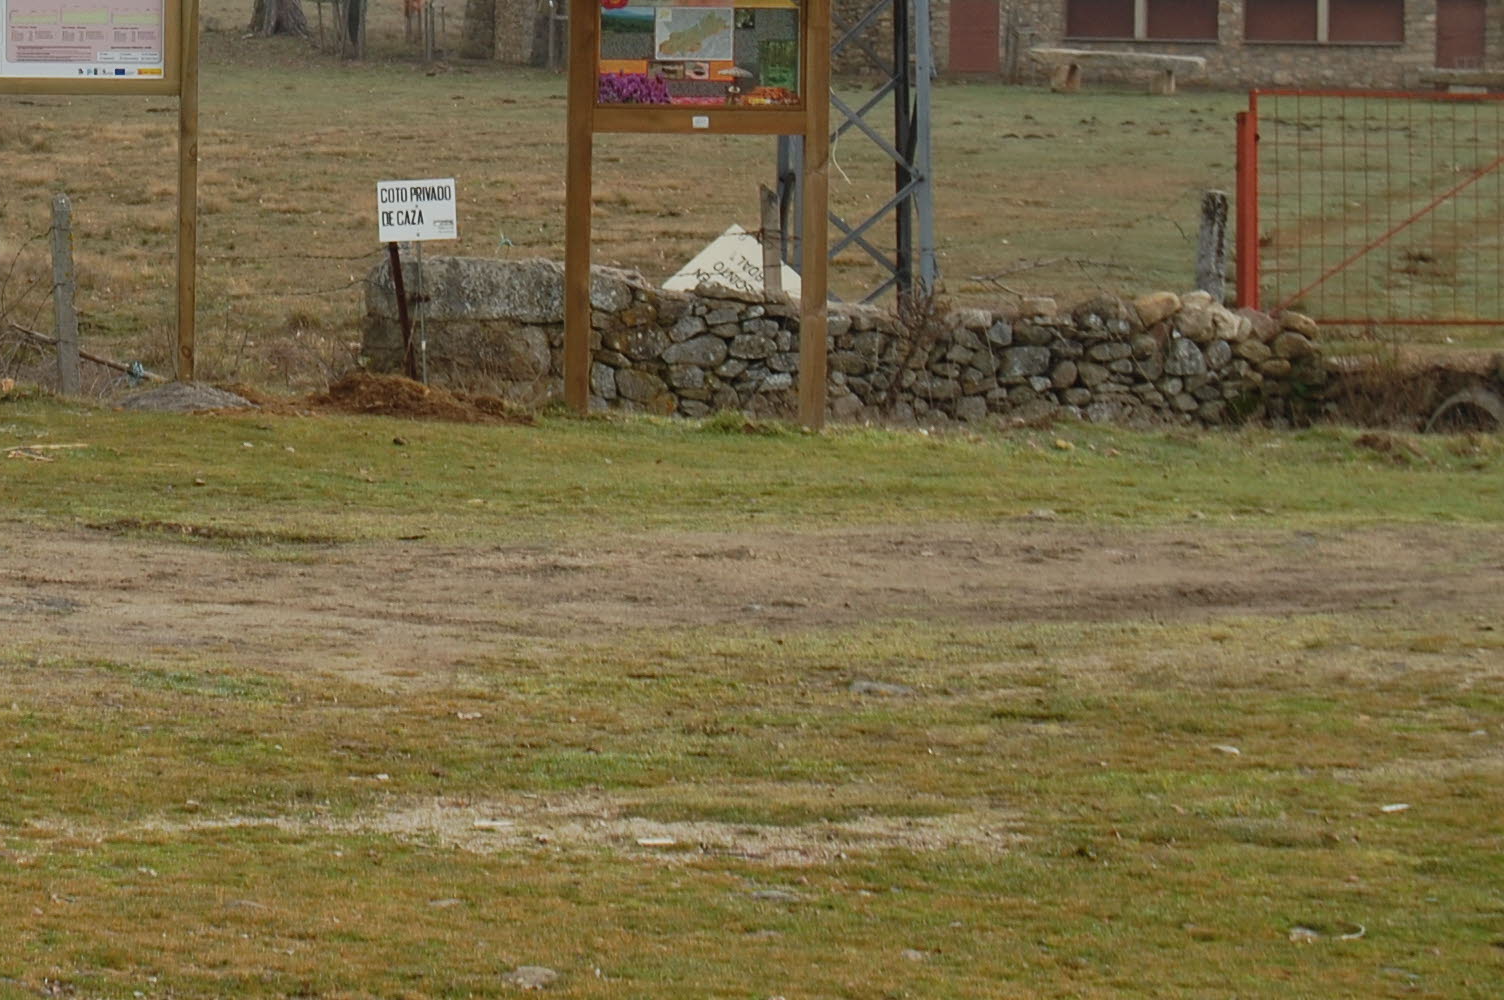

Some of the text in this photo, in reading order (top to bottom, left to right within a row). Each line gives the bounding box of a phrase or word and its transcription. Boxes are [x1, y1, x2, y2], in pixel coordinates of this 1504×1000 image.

[380, 185, 452, 203] COTO PRIVADO
[382, 211, 395, 227] DE
[396, 210, 424, 226] CAZA
